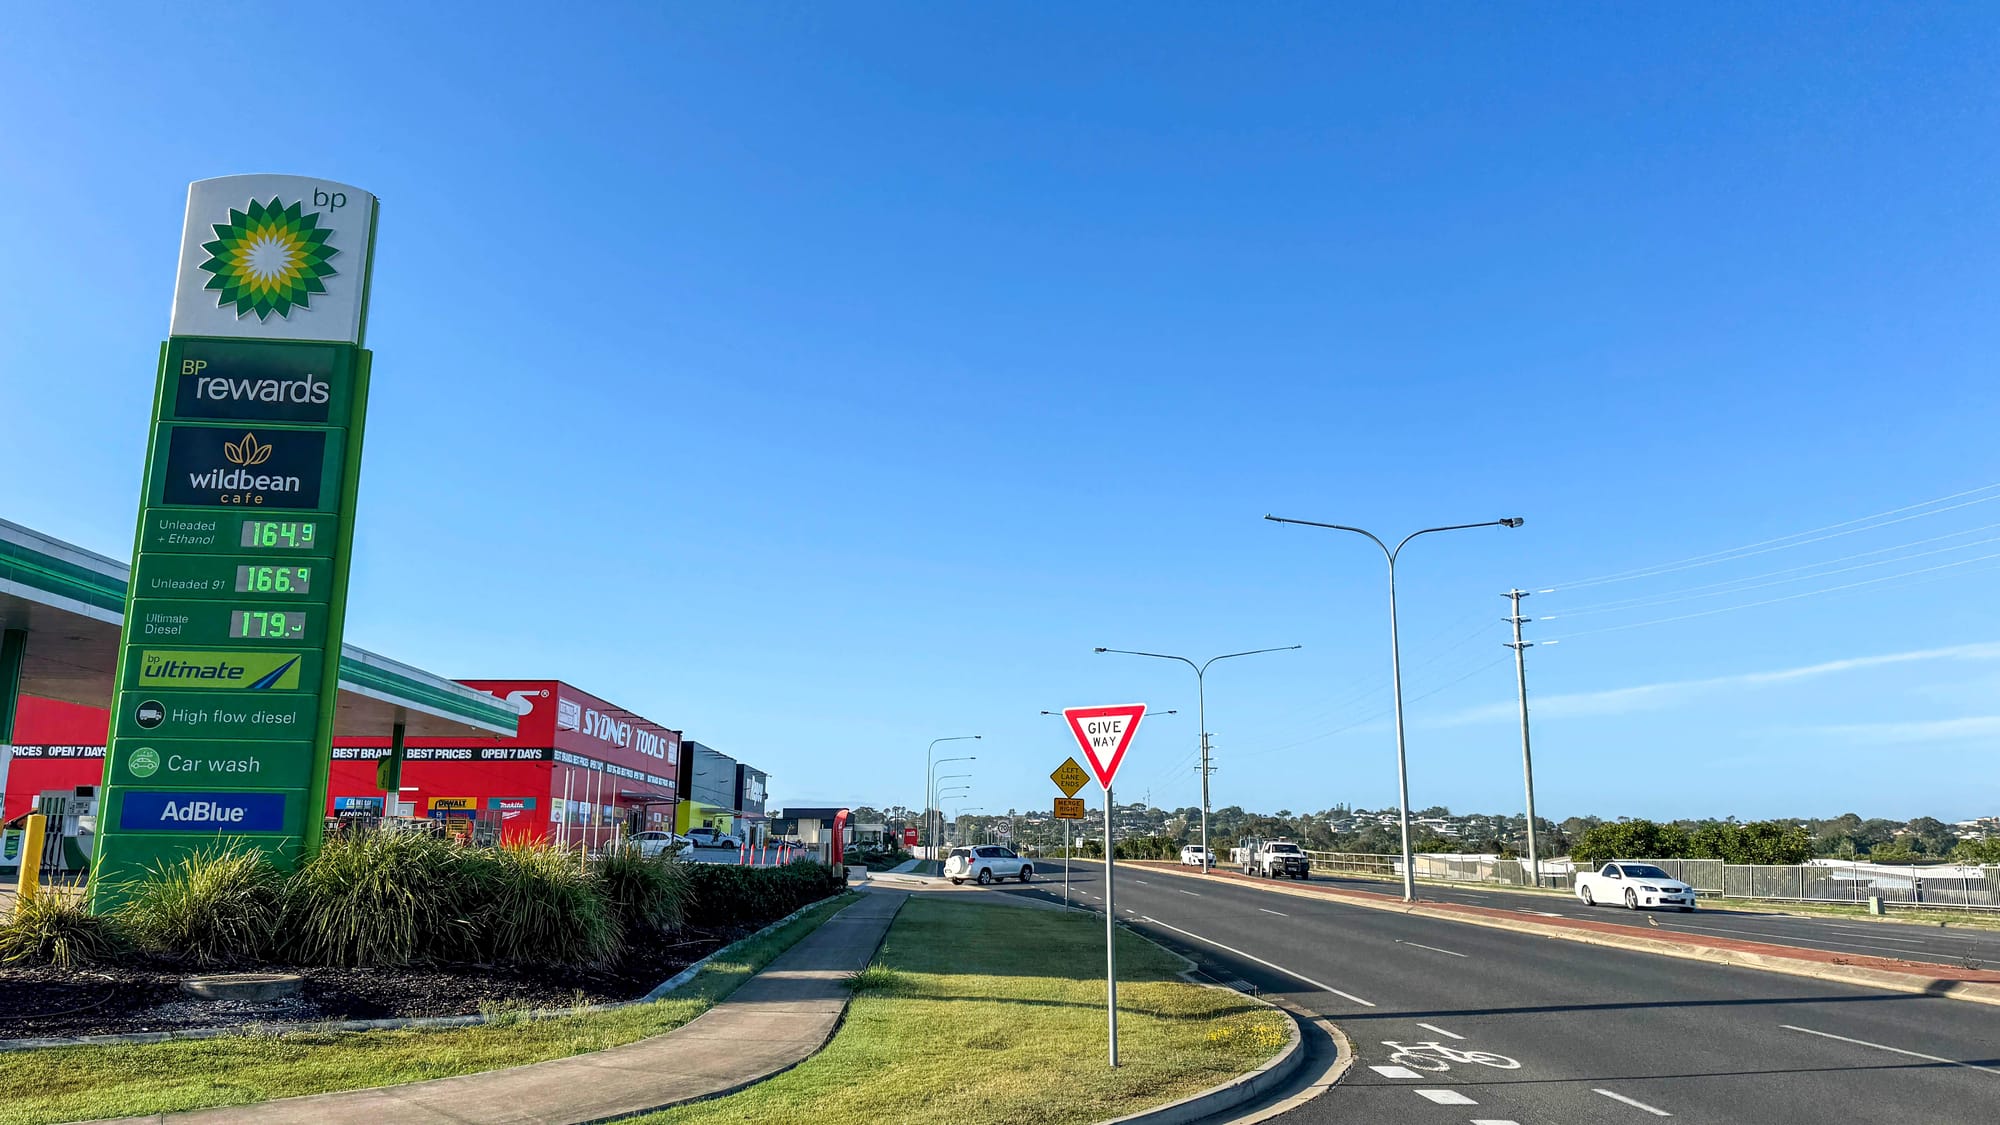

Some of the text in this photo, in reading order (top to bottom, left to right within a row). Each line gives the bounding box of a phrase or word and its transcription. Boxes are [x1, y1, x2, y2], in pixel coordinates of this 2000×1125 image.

[313, 187, 347, 213] bp
[182, 359, 208, 376] BP
[196, 373, 330, 404] rewards
[189, 468, 300, 492] wildbean
[220, 492, 263, 504] cafe
[159, 519, 216, 531] Unleaded
[168, 533, 215, 545] Ethanol
[253, 522, 314, 547] 164.9
[151, 578, 226, 590] Unleaded 91
[247, 567, 308, 592] 166.9
[146, 613, 189, 624] Ultimate
[144, 623, 182, 635] Diesel
[147, 654, 160, 666] bp
[144, 661, 245, 680] ultimate
[172, 708, 296, 726] High flow diesel
[1088, 720, 1122, 734] GIVE
[582, 708, 635, 748] SYDNEY
[635, 727, 666, 759] TOOLS
[1093, 736, 1116, 747] WAY
[12, 746, 43, 757] RICES
[48, 746, 76, 757] OPEN
[76, 746, 84, 757] 7
[332, 748, 360, 759] BEST
[406, 748, 472, 759] BEST PRICES
[481, 748, 543, 759] OPEN 7 DAYS
[167, 754, 260, 773] Car wash
